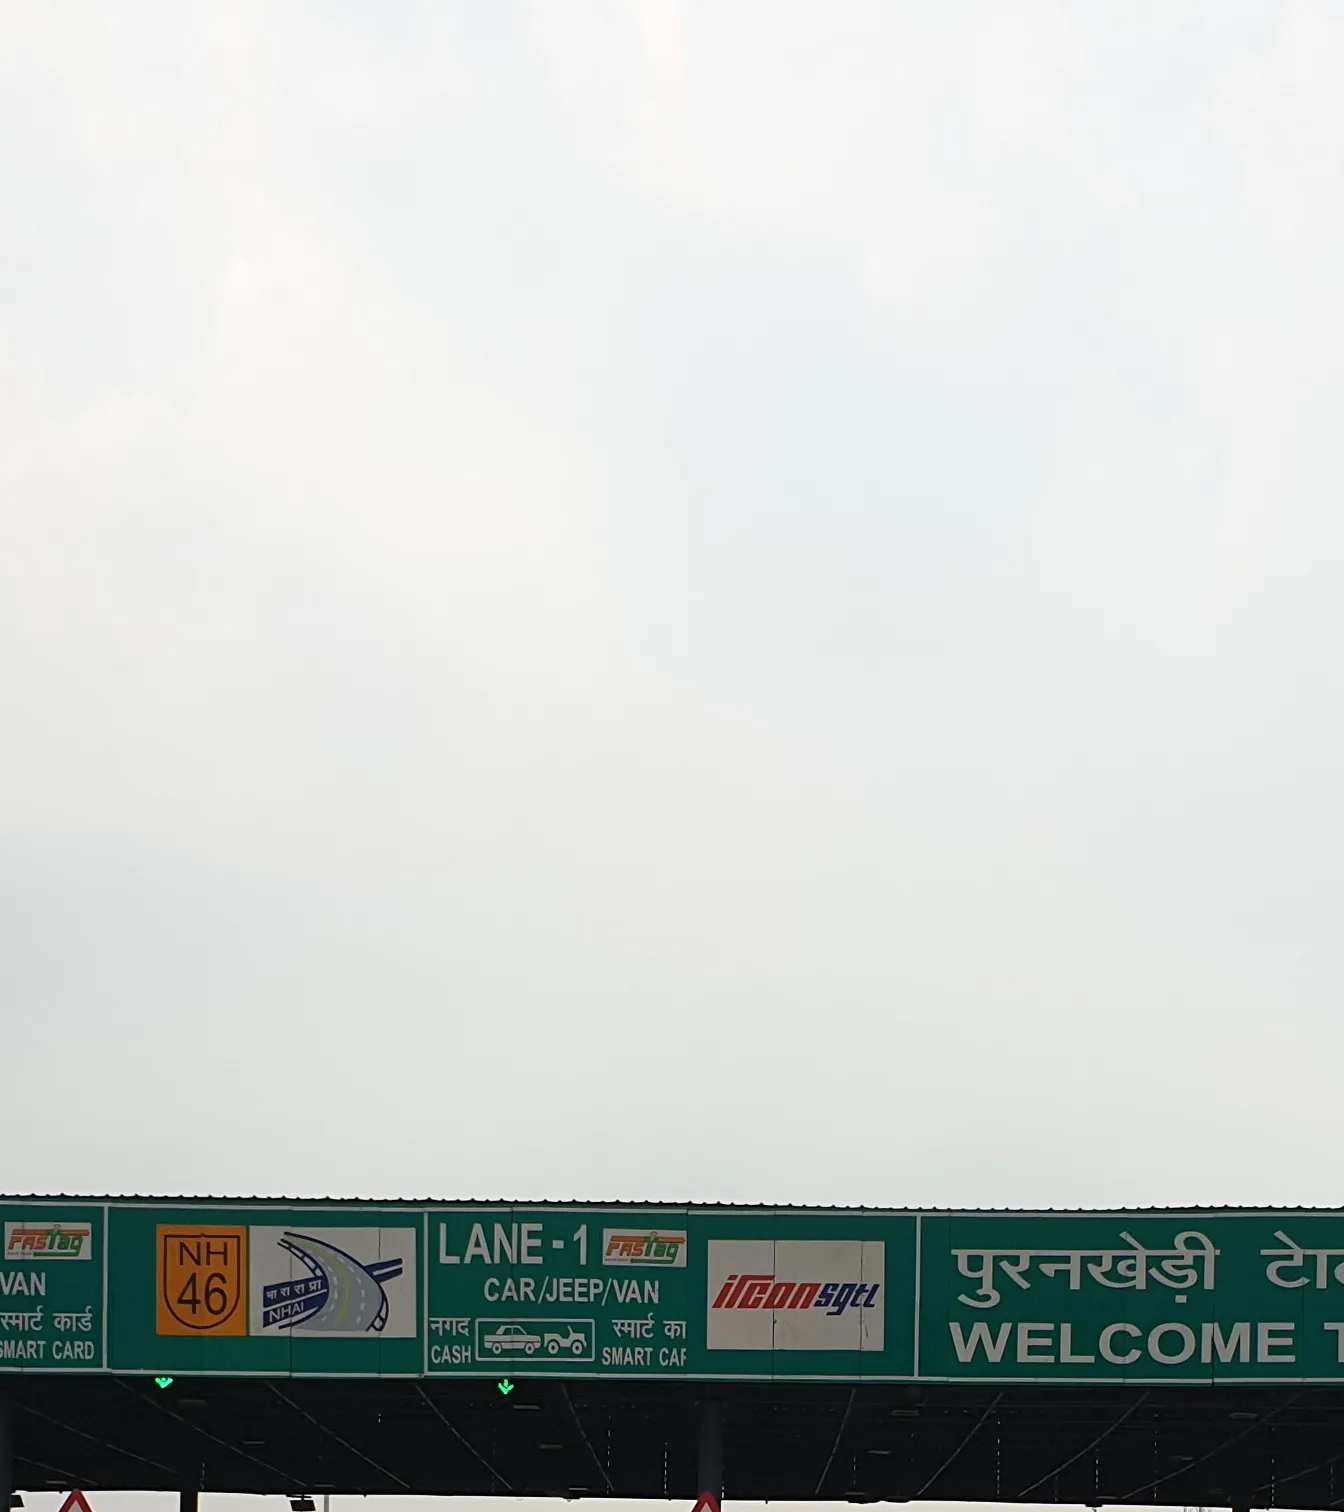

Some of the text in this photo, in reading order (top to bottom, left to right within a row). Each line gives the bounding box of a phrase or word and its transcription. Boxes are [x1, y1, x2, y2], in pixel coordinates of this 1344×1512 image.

[180, 1242, 230, 1267] NH
[177, 1272, 229, 1316] 46
[484, 1276, 659, 1306] CAR/JEEP/VAN
[0, 1305, 92, 1331] स्मार्ट कार्ड
[269, 1302, 305, 1323] NHAI
[429, 1318, 470, 1336] नगद
[612, 1313, 655, 1338] स्मार्ट
[53, 1341, 94, 1359] CARD
[432, 1346, 471, 1363] CASH
[949, 1322, 1295, 1364] WELCOME
[602, 1347, 653, 1365] SMART
